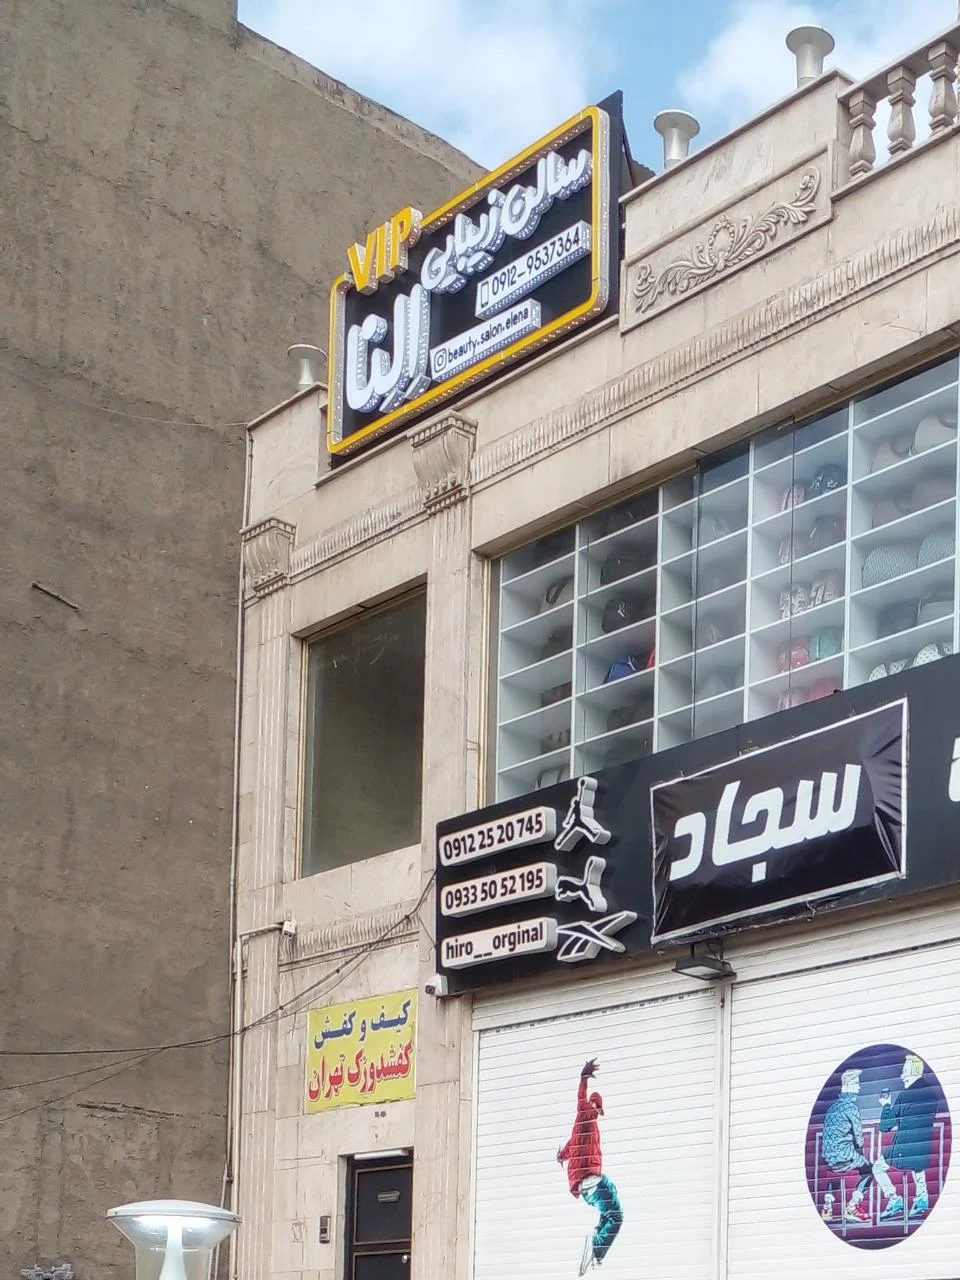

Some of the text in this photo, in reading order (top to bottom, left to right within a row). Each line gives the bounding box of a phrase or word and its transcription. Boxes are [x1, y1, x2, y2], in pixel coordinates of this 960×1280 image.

[347, 206, 423, 296] VIP
[421, 149, 594, 294] سالن زیبایی
[447, 307, 530, 363] beauty.salon.elena
[443, 814, 543, 861] 0912 25 20 745
[668, 763, 862, 882] سجاد
[445, 868, 543, 909] 0933 50 52 195
[314, 999, 411, 1049] کیف و کفش
[308, 1039, 414, 1101] کفشدوزک تهران
